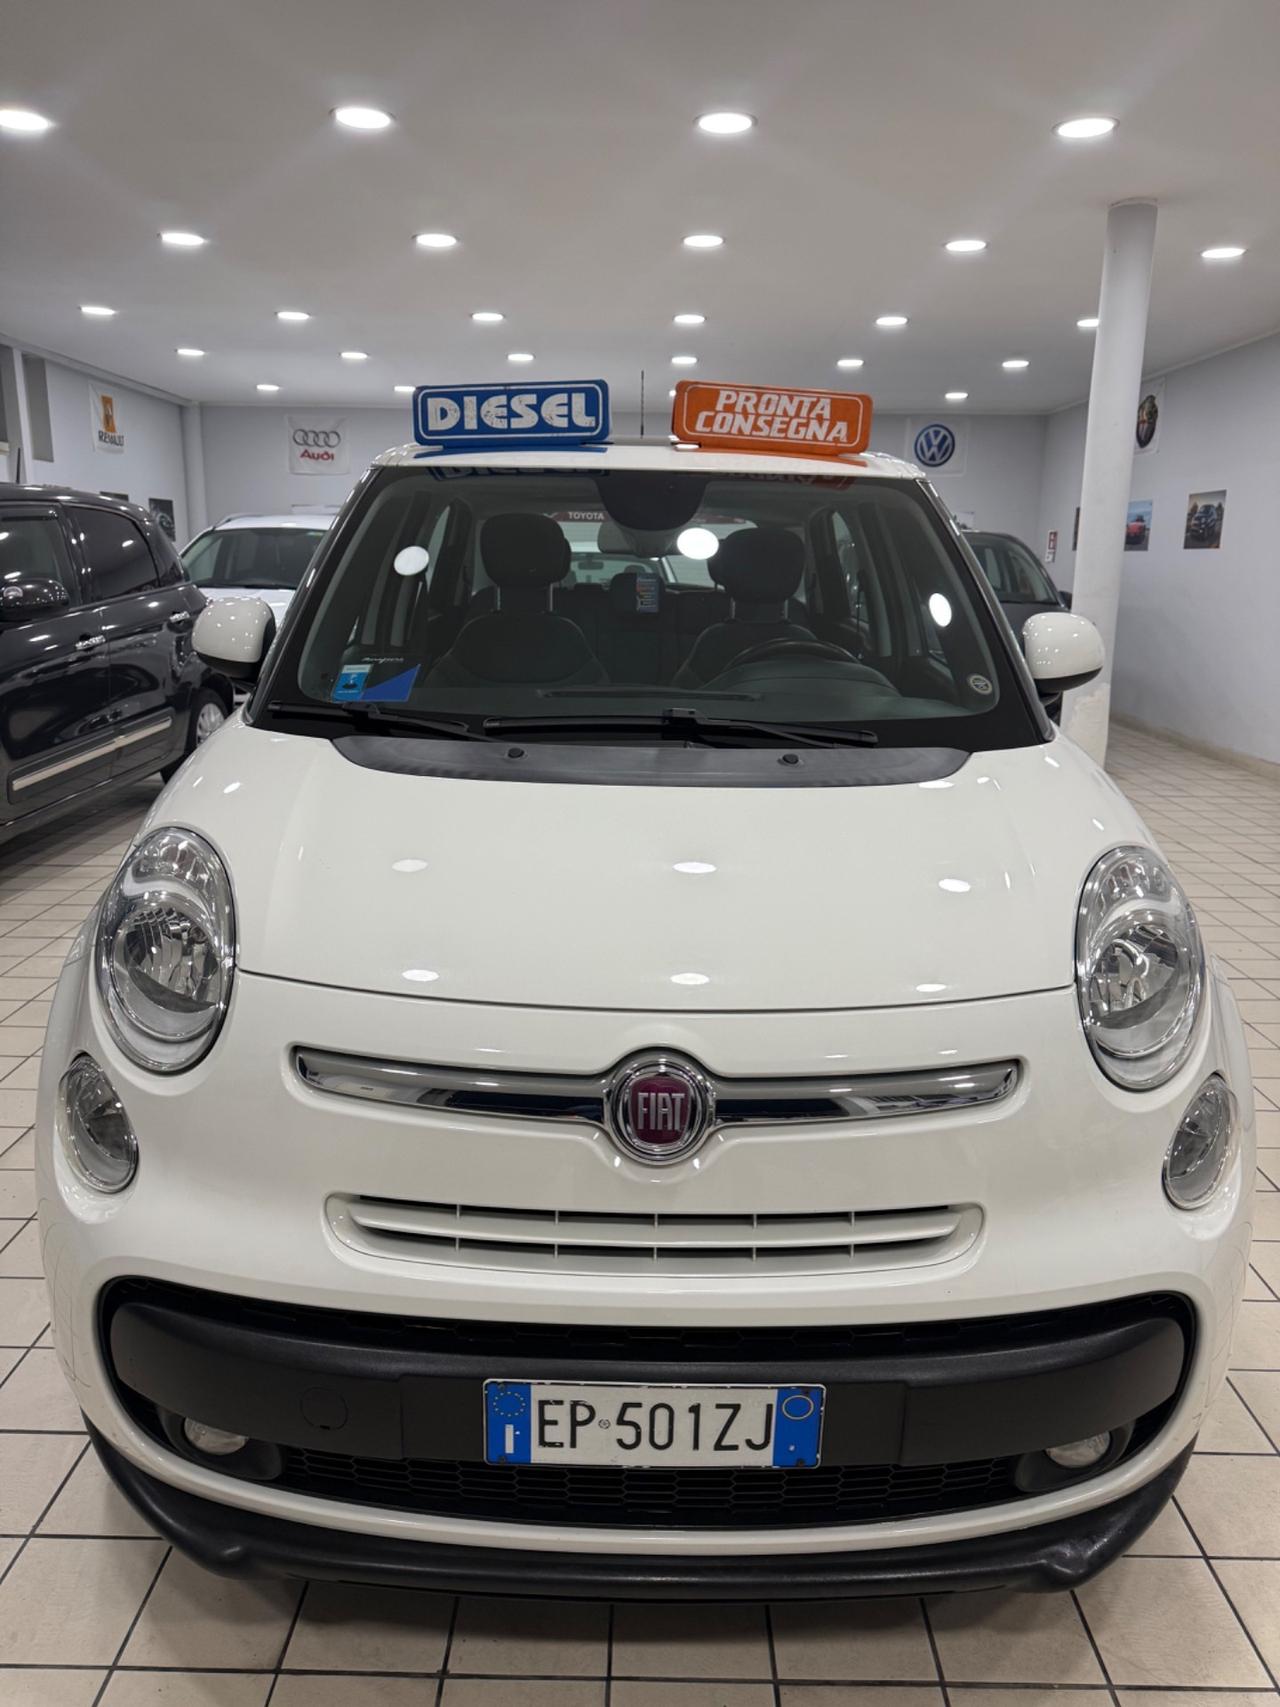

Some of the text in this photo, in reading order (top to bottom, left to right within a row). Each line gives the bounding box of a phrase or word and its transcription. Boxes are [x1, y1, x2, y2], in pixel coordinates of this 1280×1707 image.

[427, 392, 596, 431] DIESEL
[715, 390, 832, 419] PRONTA
[695, 411, 848, 442] CONSEGNA
[299, 449, 335, 461] Audi
[567, 511, 604, 520] TOYOTA
[637, 1092, 685, 1131] FIAT
